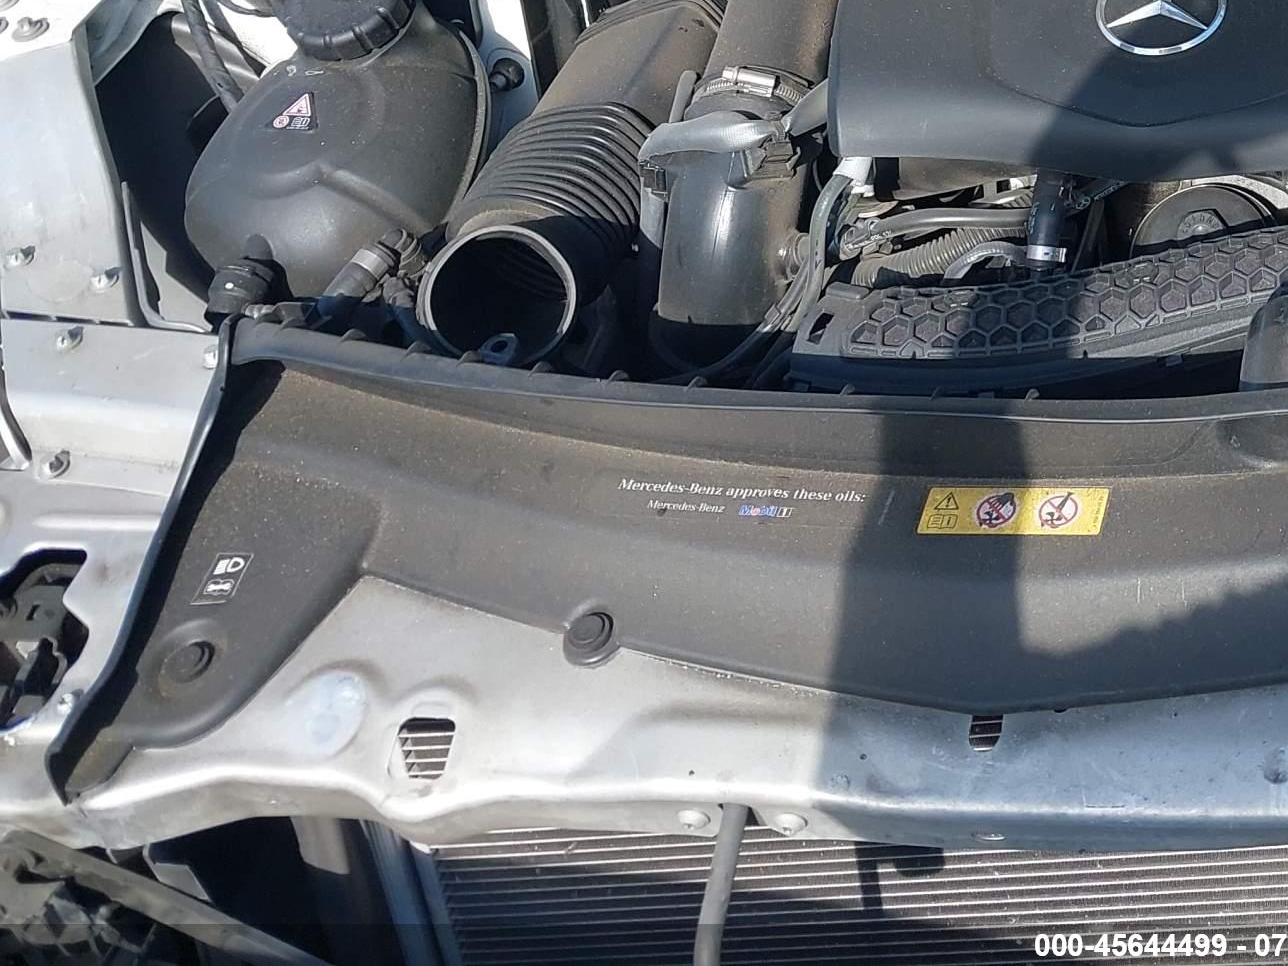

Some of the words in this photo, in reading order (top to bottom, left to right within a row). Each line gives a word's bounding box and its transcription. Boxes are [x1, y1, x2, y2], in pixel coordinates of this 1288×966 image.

[617, 478, 723, 496] Mercedes-Benz
[726, 487, 789, 500] approves
[793, 488, 832, 501] these
[835, 491, 867, 502] oils:
[647, 499, 726, 514] Mercedes-Benz
